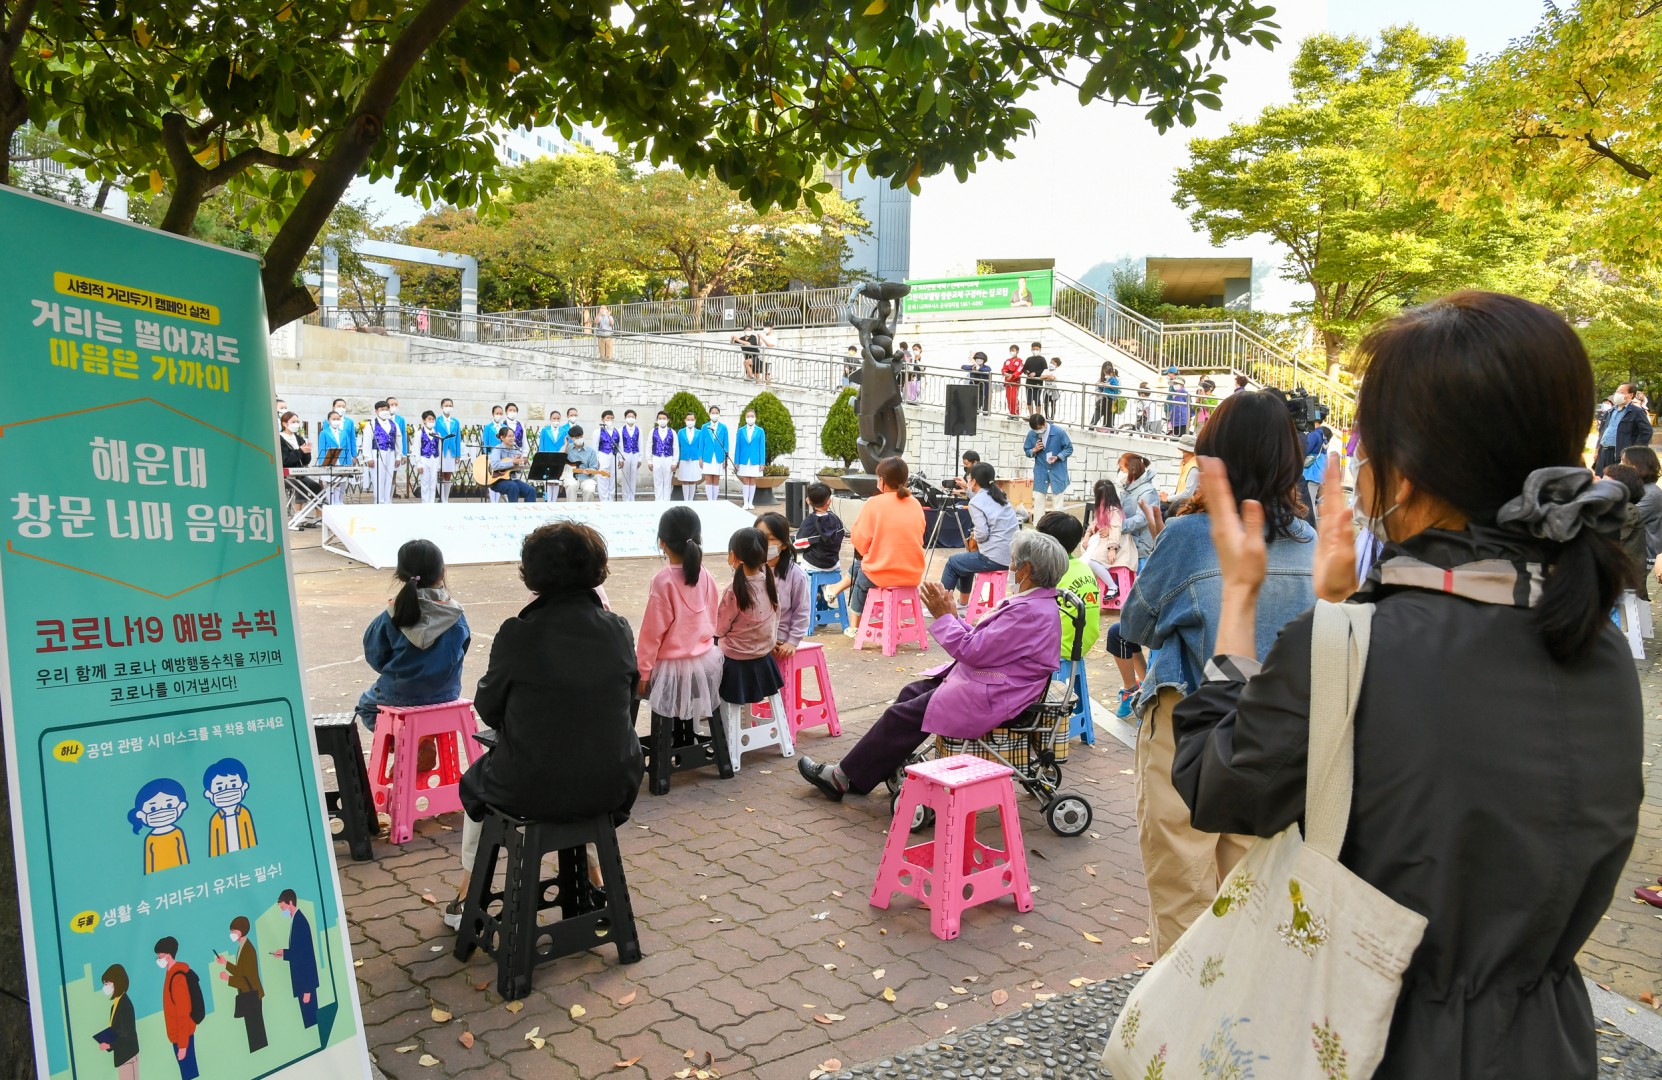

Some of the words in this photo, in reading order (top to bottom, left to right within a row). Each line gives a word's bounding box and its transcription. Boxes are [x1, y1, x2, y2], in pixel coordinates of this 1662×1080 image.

[67, 279, 104, 298] 사회적
[106, 287, 153, 309] 거리두기
[155, 296, 187, 315] 캠페인
[189, 303, 211, 321] 실천
[31, 299, 123, 344] 거리는
[135, 319, 240, 364] 멀어져도
[49, 337, 139, 380] 마음은
[151, 355, 229, 392] 가까이
[89, 436, 208, 488] 해운대
[10, 492, 96, 538] 창문
[106, 499, 174, 541] 너머
[185, 504, 275, 543] 음악회
[35, 615, 164, 654] 코로나19
[173, 612, 223, 643] 예방
[231, 609, 278, 640] 수칙
[36, 667, 69, 686] 우리
[75, 664, 107, 683] 함께
[114, 659, 156, 677] 코로나
[161, 652, 245, 674] 예방행동수칙을
[249, 649, 282, 666] 지키며
[110, 680, 168, 702] 코로나를
[173, 675, 238, 695] 이겨냅시다!
[61, 745, 79, 757] 하나
[86, 741, 114, 760] 공연
[117, 737, 144, 754] 관람
[147, 733, 160, 748] 시
[163, 728, 209, 745] 마스크를
[211, 725, 223, 739] 꼭
[225, 721, 245, 736] 착용
[247, 716, 285, 733] 해주세요
[102, 904, 132, 928] 생활
[136, 900, 151, 916] 속
[155, 882, 209, 911] 거리두기
[213, 872, 251, 894] 유지는
[254, 862, 283, 883] 필수!
